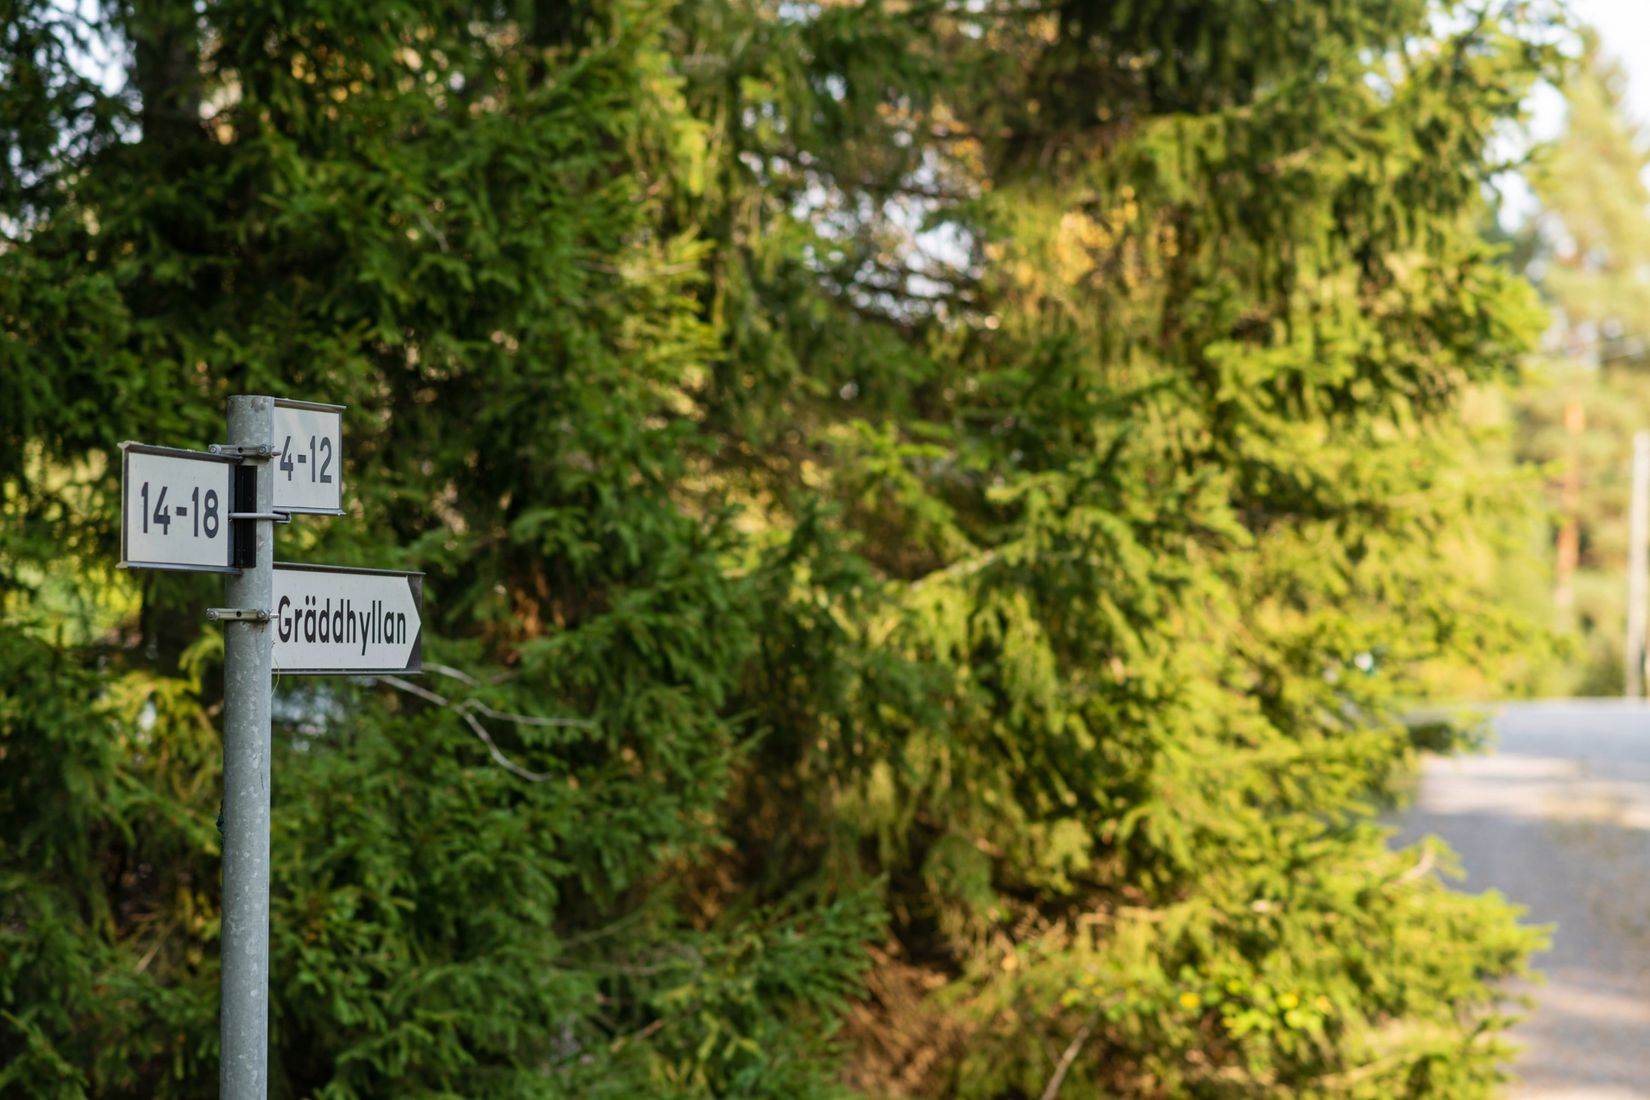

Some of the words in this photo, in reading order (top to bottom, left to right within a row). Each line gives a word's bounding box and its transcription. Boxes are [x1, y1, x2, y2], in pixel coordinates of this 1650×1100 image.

[279, 435, 332, 484] 4-12
[141, 481, 219, 539] 14-18
[277, 595, 407, 656] Gräddhyllan
